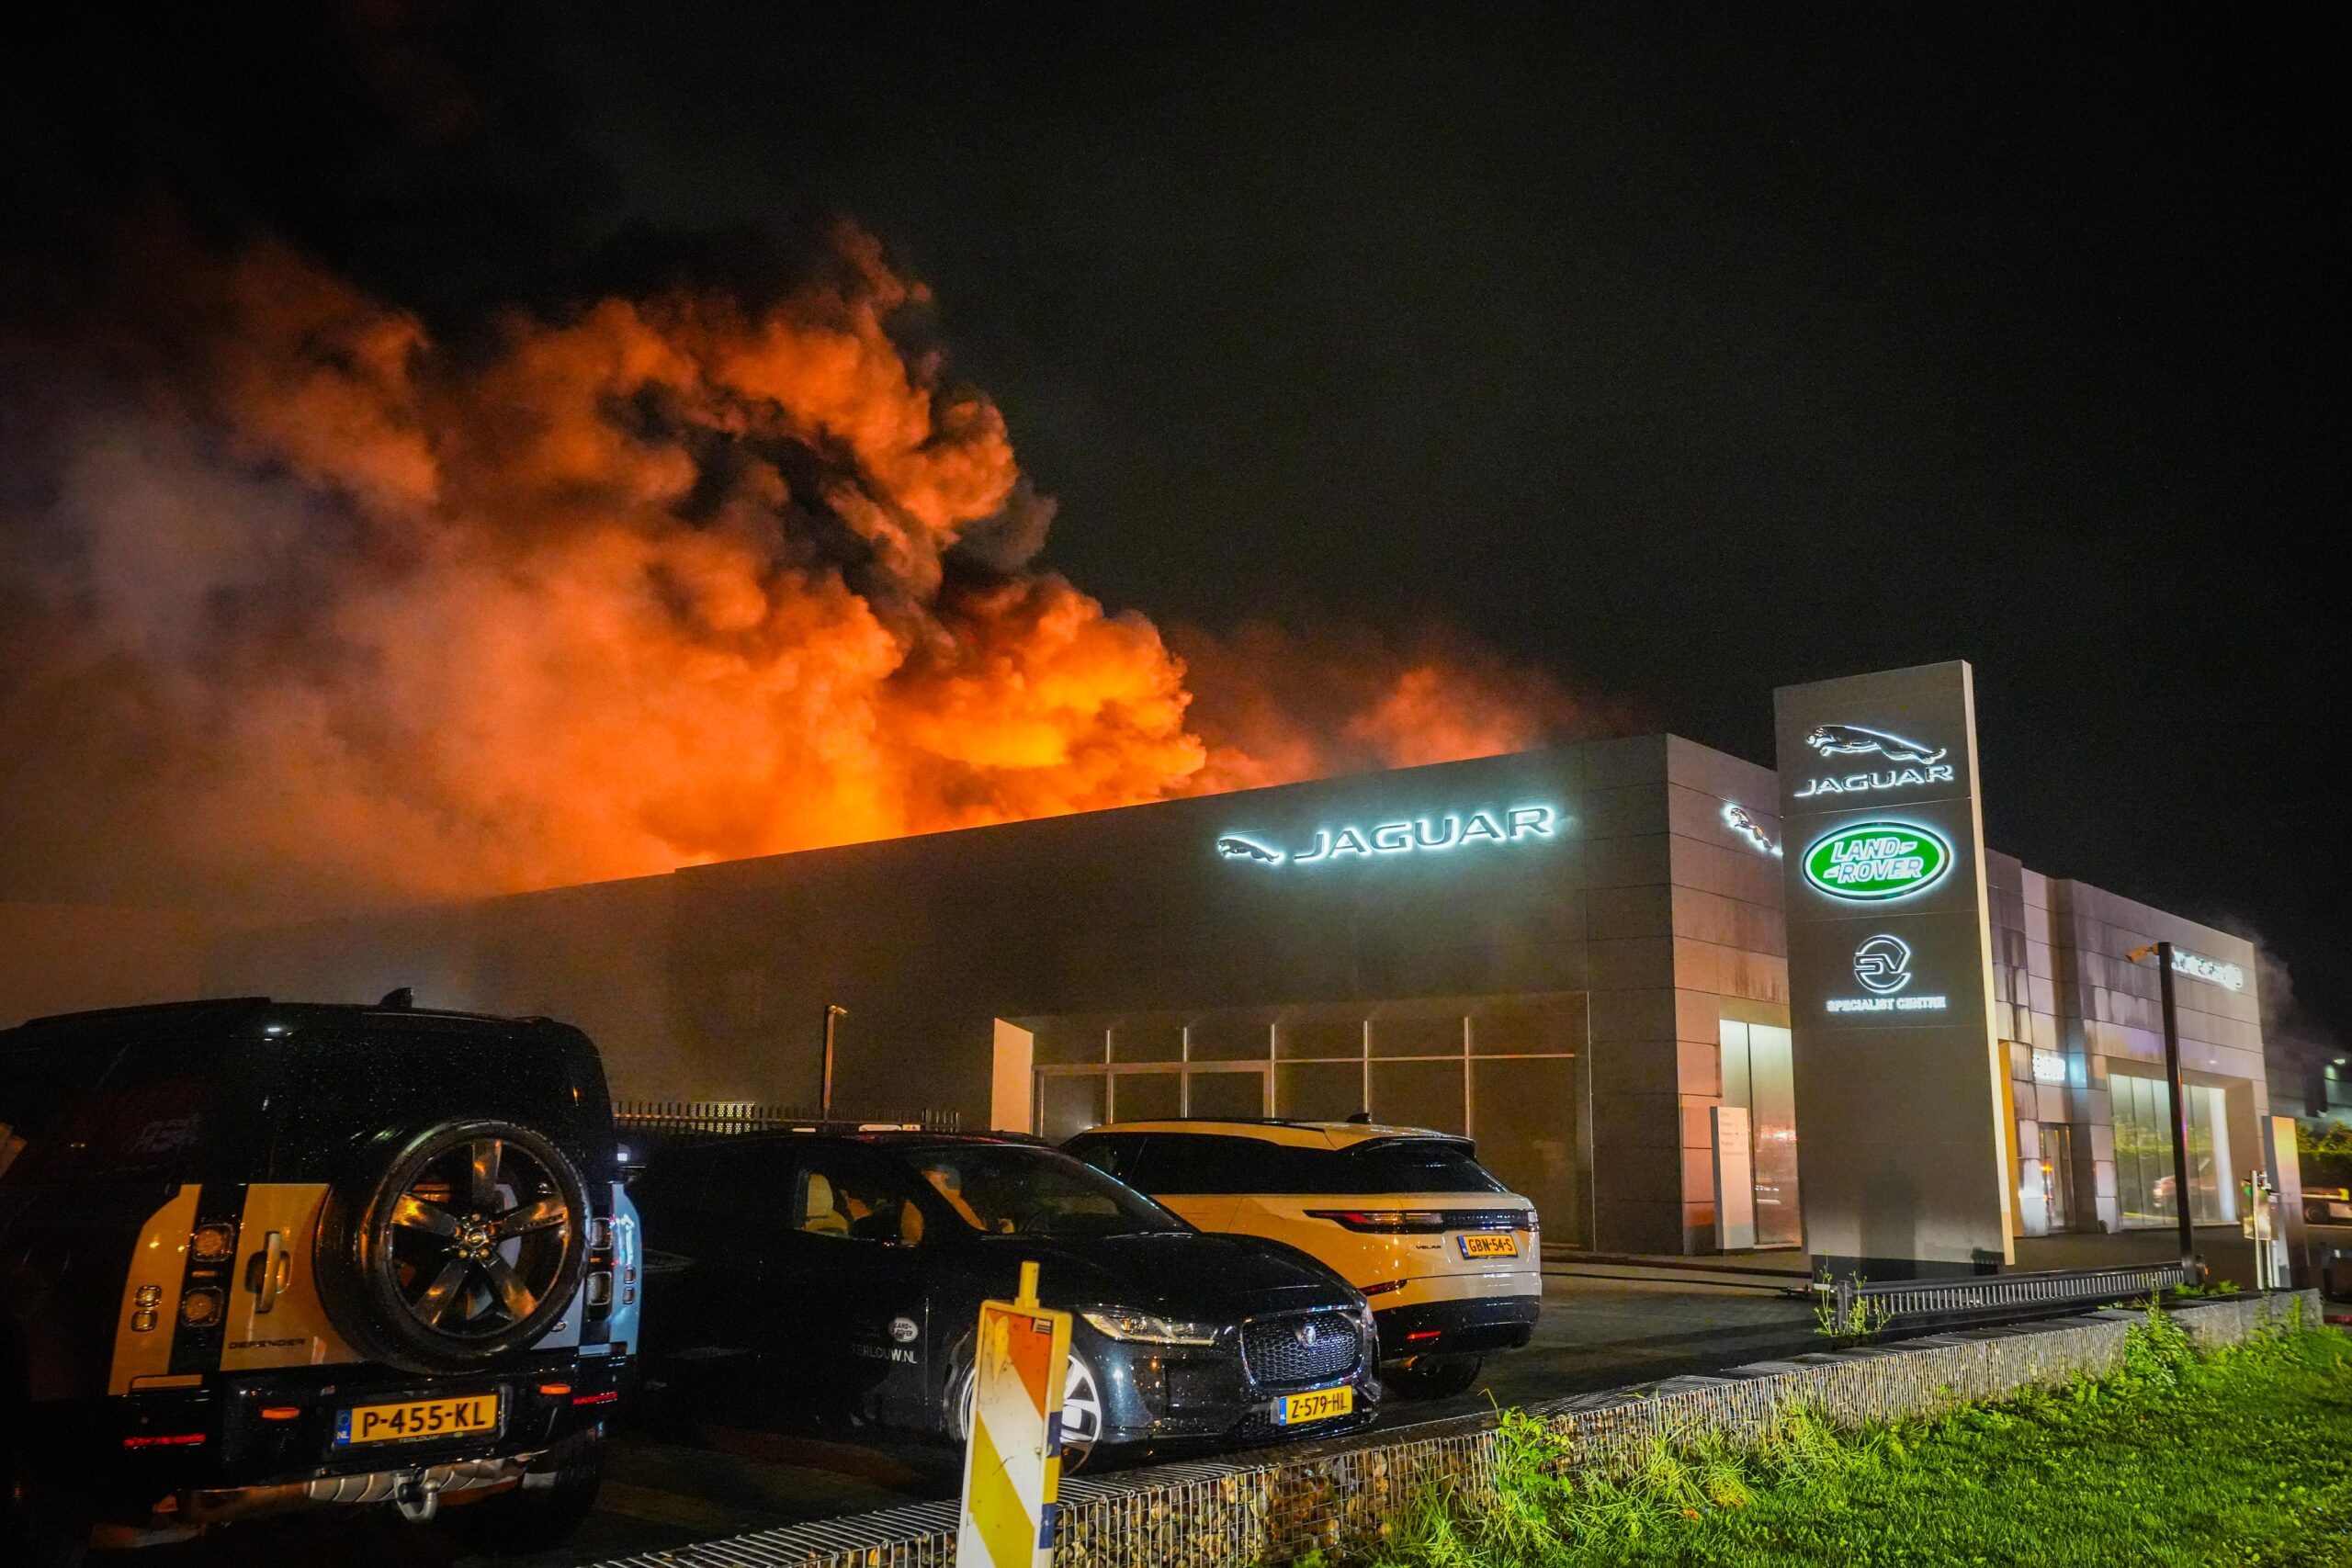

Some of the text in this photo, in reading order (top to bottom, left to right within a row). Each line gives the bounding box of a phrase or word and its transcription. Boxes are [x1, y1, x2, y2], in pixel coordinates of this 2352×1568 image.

[1793, 765, 1954, 798] JAGUAR
[1293, 807, 1555, 862] JAGUAR
[1826, 997, 1946, 1011] SPECIALIST CENTRE
[1468, 1238, 1513, 1253] GBN-54-S
[229, 1338, 306, 1349] DEFENDER
[1291, 1392, 1348, 1418] Z-579-HL
[362, 1402, 486, 1438] P-455-KL
[337, 1430, 349, 1439] NL
[398, 1435, 440, 1443] TERLOUW
